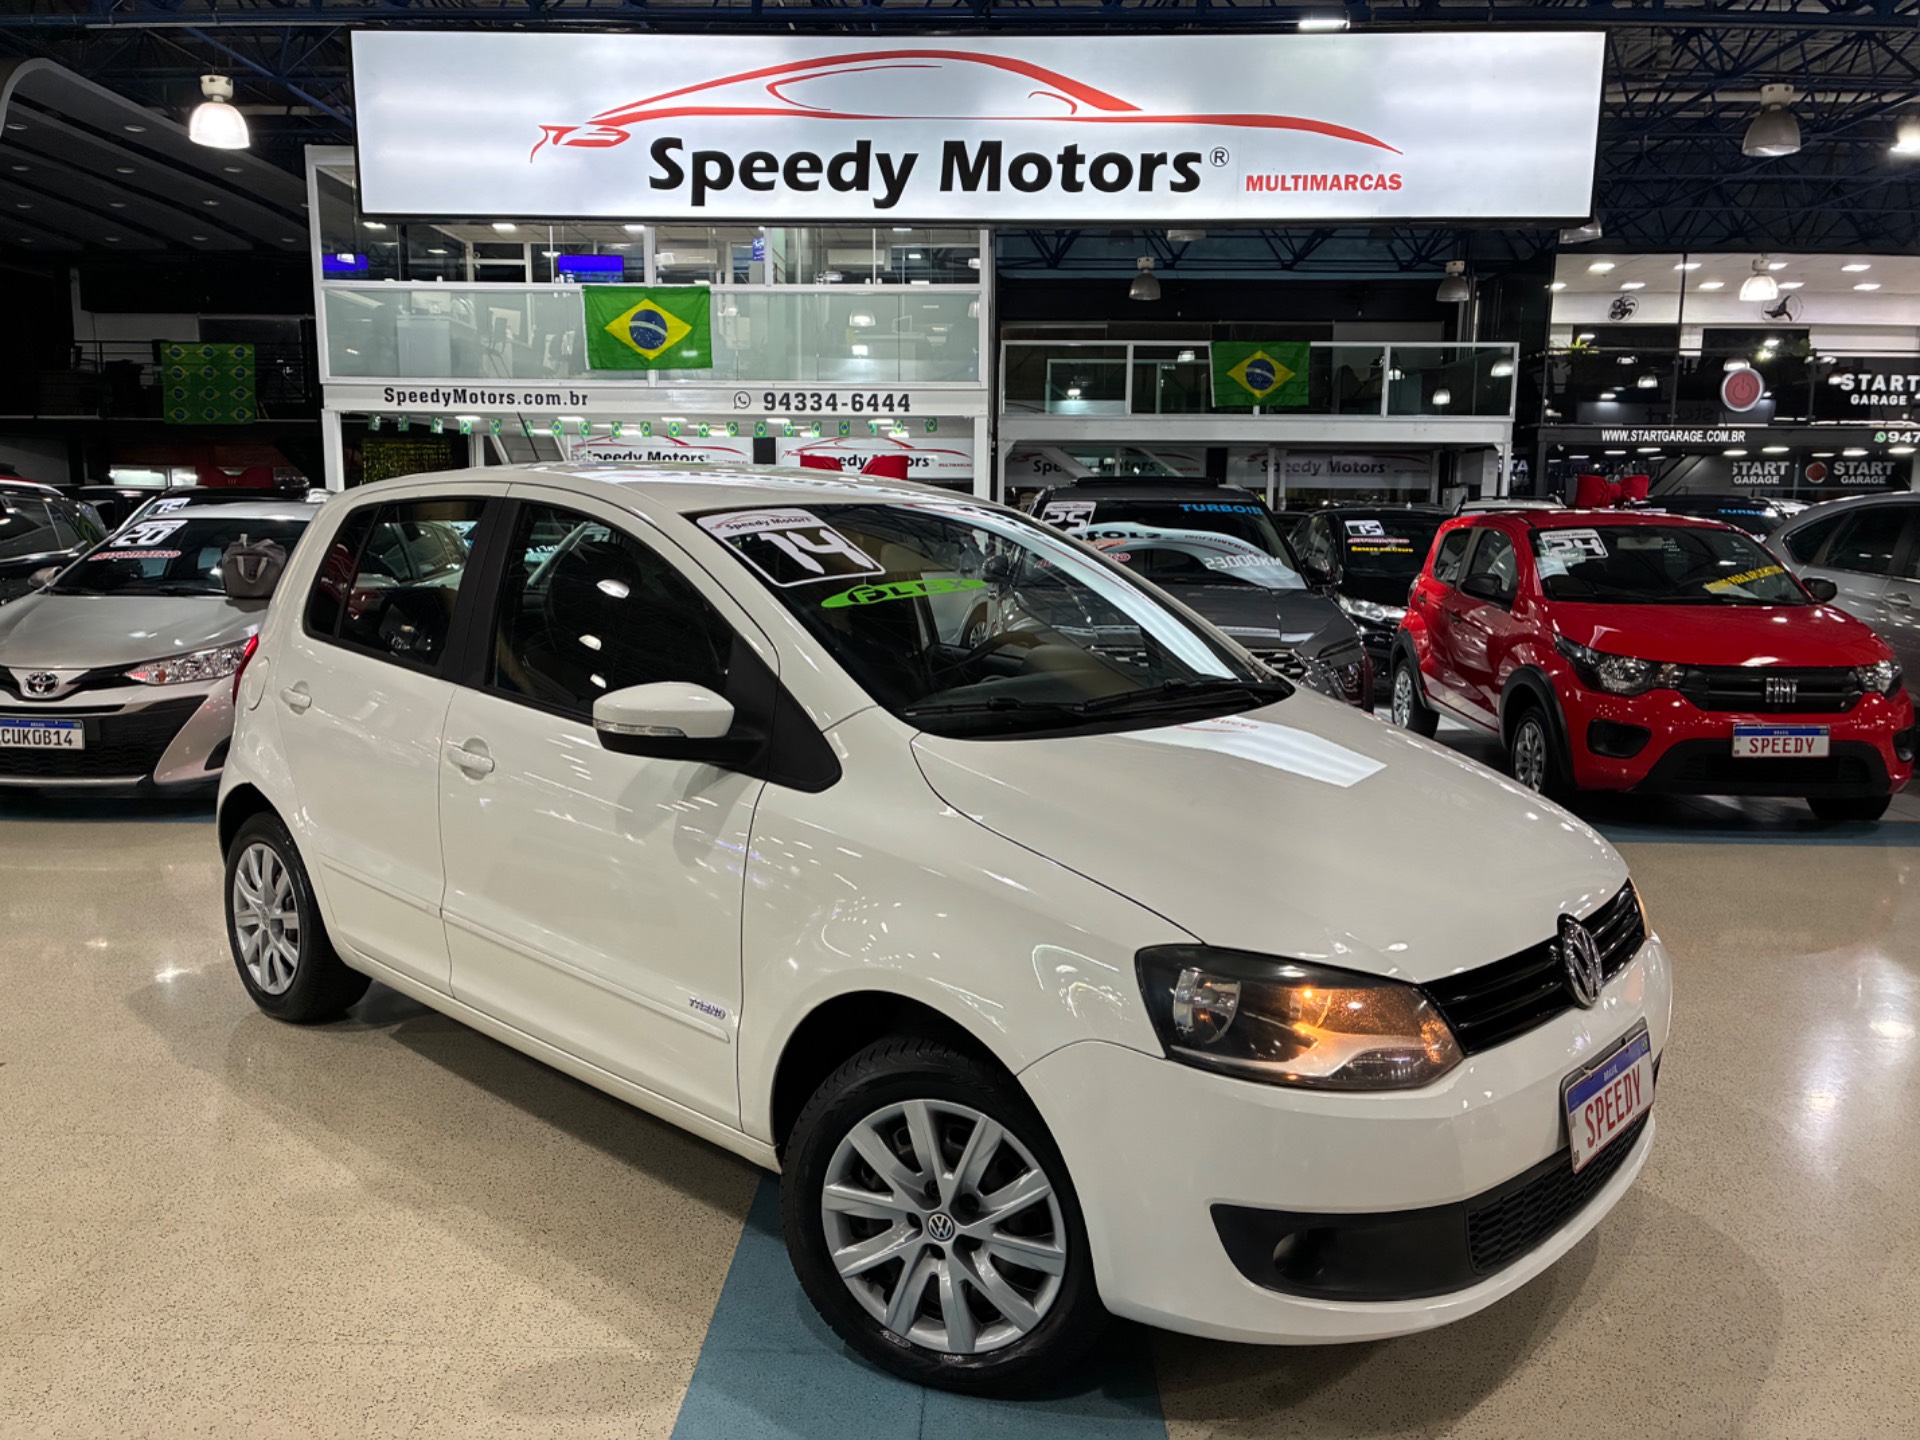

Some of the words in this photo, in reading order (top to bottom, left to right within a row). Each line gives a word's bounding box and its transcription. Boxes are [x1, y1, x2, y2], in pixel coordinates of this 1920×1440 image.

[649, 137, 919, 208] Speedy
[1245, 174, 1402, 191] MULTIMARCAS
[1840, 373, 1920, 391] START
[384, 387, 588, 406] SpeedyMotors.com.br
[763, 392, 911, 413] 94334-6444
[1850, 394, 1908, 406] GARAGE
[1601, 429, 1746, 443] WWW.STARTGARAGE.COM.BR
[1887, 431, 1920, 443] 947
[1834, 461, 1895, 475] START
[1734, 475, 1779, 485] GARAGE
[1841, 475, 1886, 484] GARAGE
[858, 578, 965, 603] FLEX
[1766, 677, 1799, 703] FIAT
[1749, 737, 1815, 754] SPEEDY
[1584, 1063, 1641, 1149] SPEEDY
